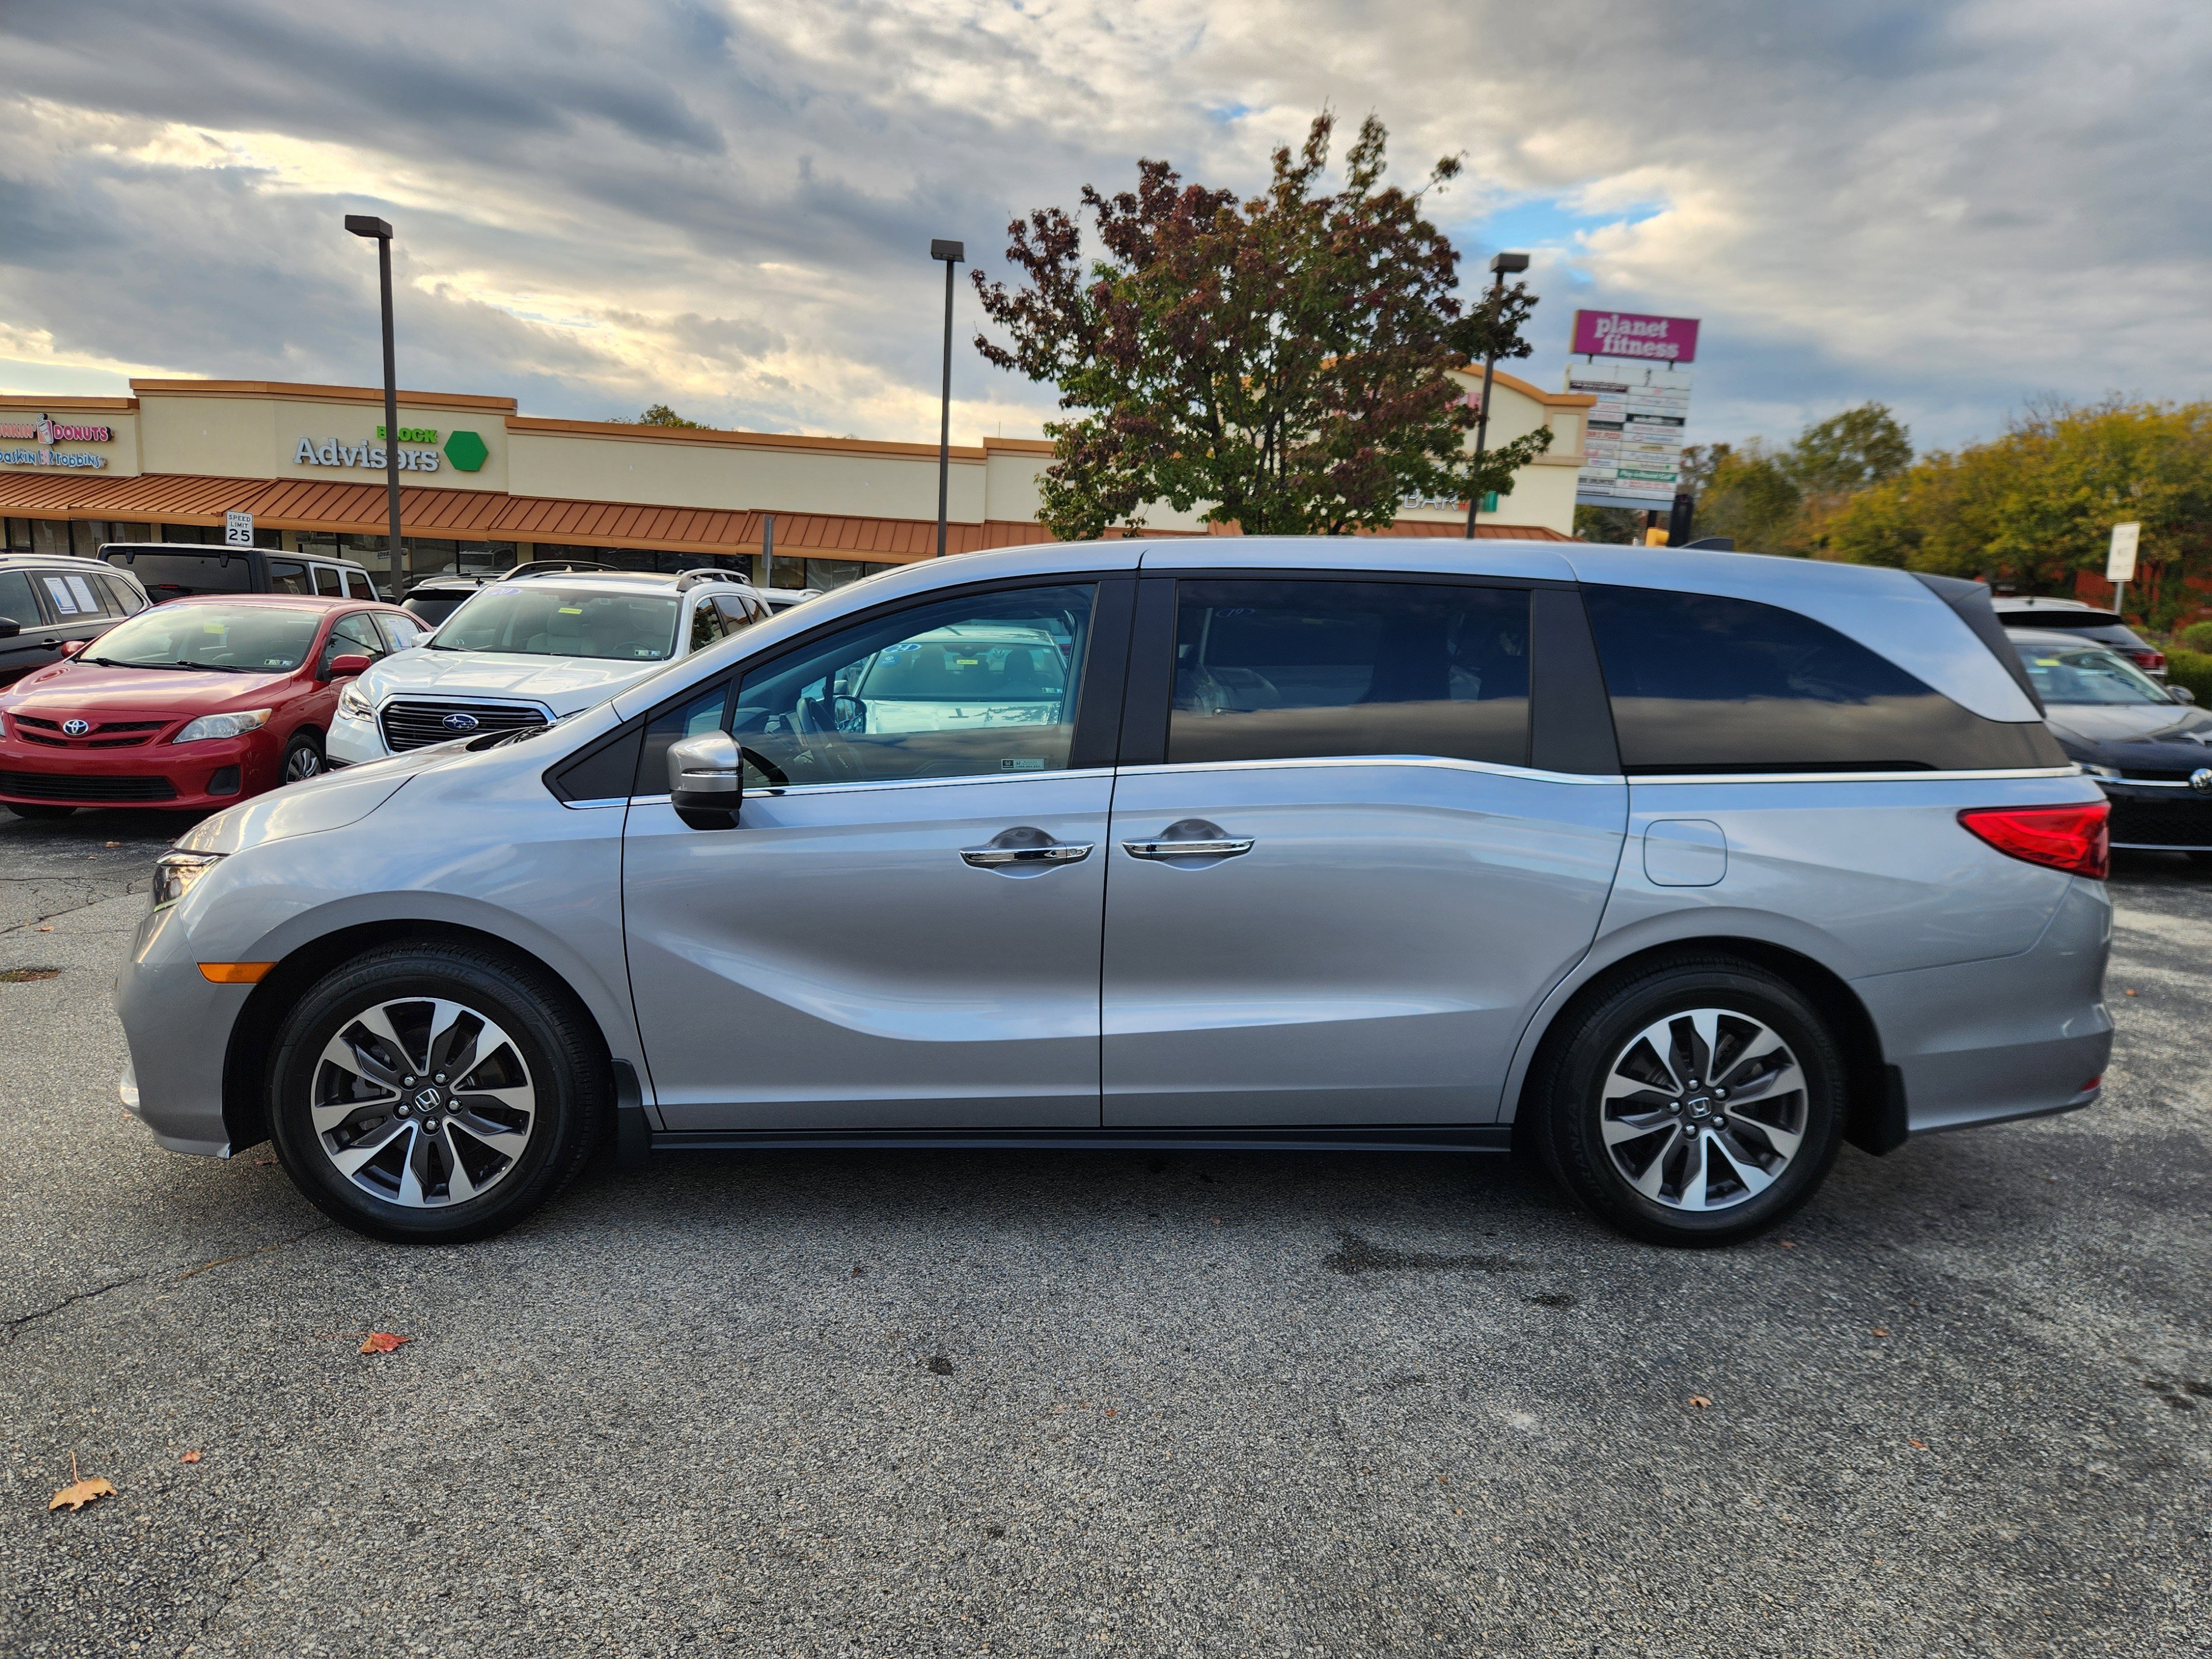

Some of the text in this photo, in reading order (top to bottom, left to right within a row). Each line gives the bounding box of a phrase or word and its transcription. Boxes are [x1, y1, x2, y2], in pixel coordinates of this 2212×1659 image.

[1593, 314, 1669, 339] planet
[1601, 334, 1679, 358] fitness
[0, 424, 109, 442] NKIN' DONUTS
[377, 426, 438, 443] BOCK
[228, 528, 251, 542] 25
